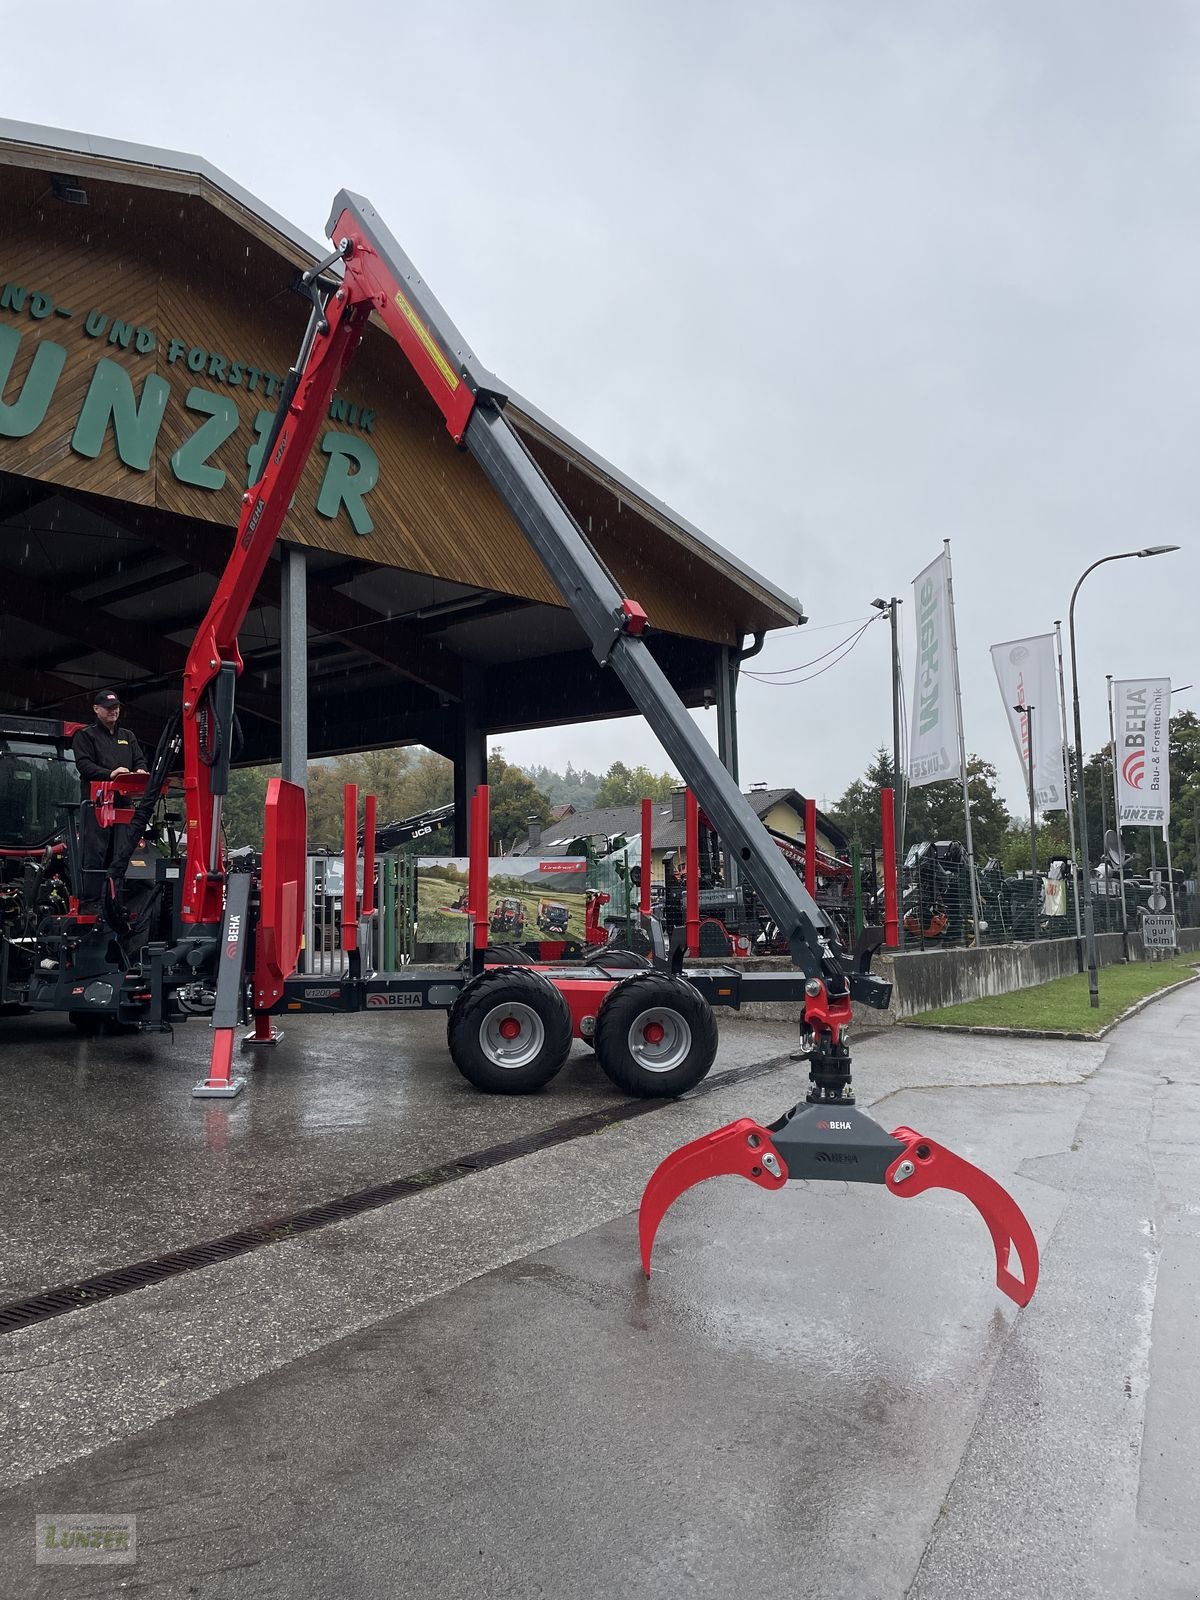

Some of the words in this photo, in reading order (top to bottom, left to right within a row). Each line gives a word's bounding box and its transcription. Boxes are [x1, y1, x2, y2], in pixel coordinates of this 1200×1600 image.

[84, 310, 157, 354] UND
[168, 338, 376, 433] FORSTTNIK
[249, 500, 265, 532] BEHA
[1125, 688, 1147, 748] BEHA
[1152, 688, 1162, 753] Forsttechnik
[1152, 756, 1160, 764] &
[1151, 767, 1160, 791] Bau-
[411, 825, 433, 839] JCB
[227, 914, 241, 942] BEHA
[1145, 918, 1173, 926] Komm
[1152, 928, 1167, 936] gut
[388, 994, 420, 1005] BEHA
[829, 1121, 852, 1130] BEHA
